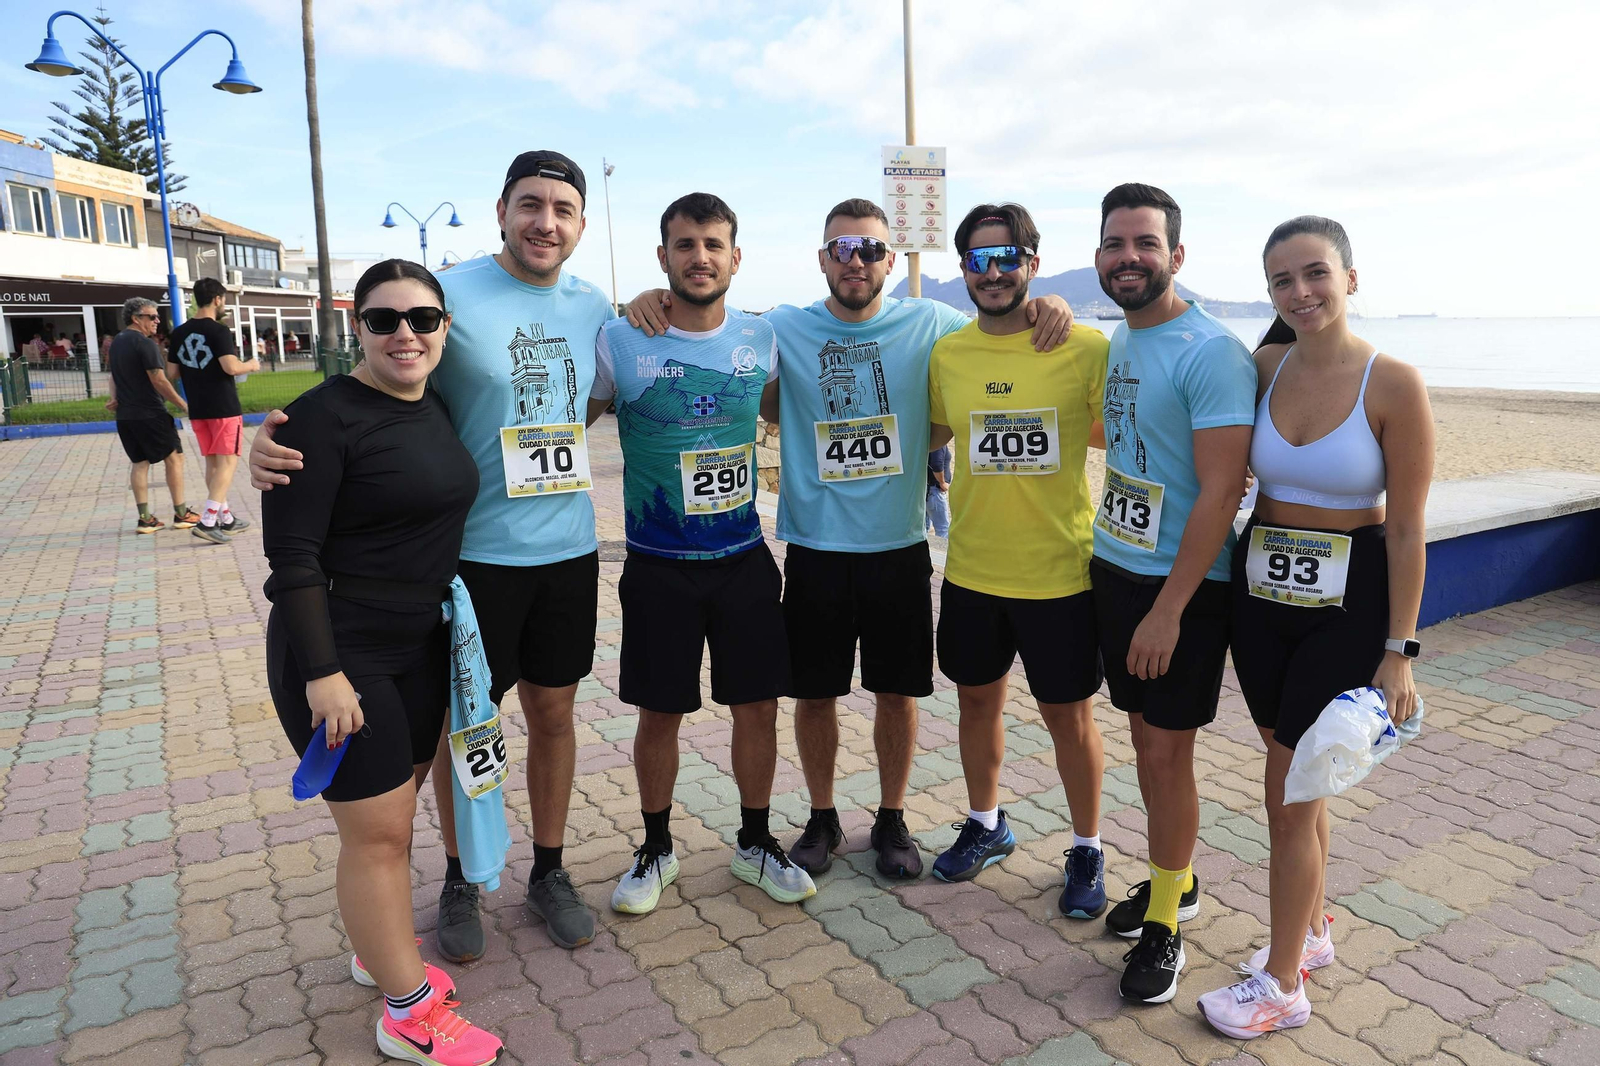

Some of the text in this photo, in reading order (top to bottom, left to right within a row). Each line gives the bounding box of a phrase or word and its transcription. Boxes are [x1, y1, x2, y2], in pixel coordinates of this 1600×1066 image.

[13, 292, 27, 302] DE
[28, 293, 51, 302] NATI
[538, 337, 568, 345] CARRERA
[848, 341, 879, 350] CARRERA
[540, 343, 572, 361] URBANA
[848, 346, 881, 365] URBANA
[636, 355, 658, 367] MAT
[637, 366, 684, 378] RUNNERS
[985, 382, 1013, 394] YELLOW
[828, 422, 884, 434] CARRERA URBANA
[984, 417, 1042, 426] CARRERA URBANA
[1012, 424, 1043, 432] ALGECIRAS
[517, 430, 575, 441] CARRERA URBANA
[829, 433, 849, 441] CIUDAD
[856, 429, 885, 438] ALGECIRAS
[518, 438, 576, 449] CIUDAD DE ALGECIRAS
[825, 435, 892, 463] 440
[978, 431, 1049, 458] 409
[528, 445, 573, 474] 10
[695, 451, 746, 465] CARRERA URBANA
[696, 457, 746, 472] CIUDAD DE ALGECIRAS
[692, 463, 748, 497] 290
[1108, 475, 1149, 496] CARRERA URBANA
[1107, 482, 1149, 504] CIUDAD DE ALGECIRAS
[1291, 490, 1324, 504] NIKE
[1354, 496, 1382, 507] NIKE
[1103, 490, 1151, 530] 413
[1263, 535, 1296, 546] CARRERA
[1296, 539, 1332, 550] URBANA
[1262, 543, 1332, 558] CIUDAD DE ALGECIRAS
[1267, 553, 1320, 585] 93
[463, 727, 497, 744] CARRERA
[466, 734, 499, 751] CIUDAD DE
